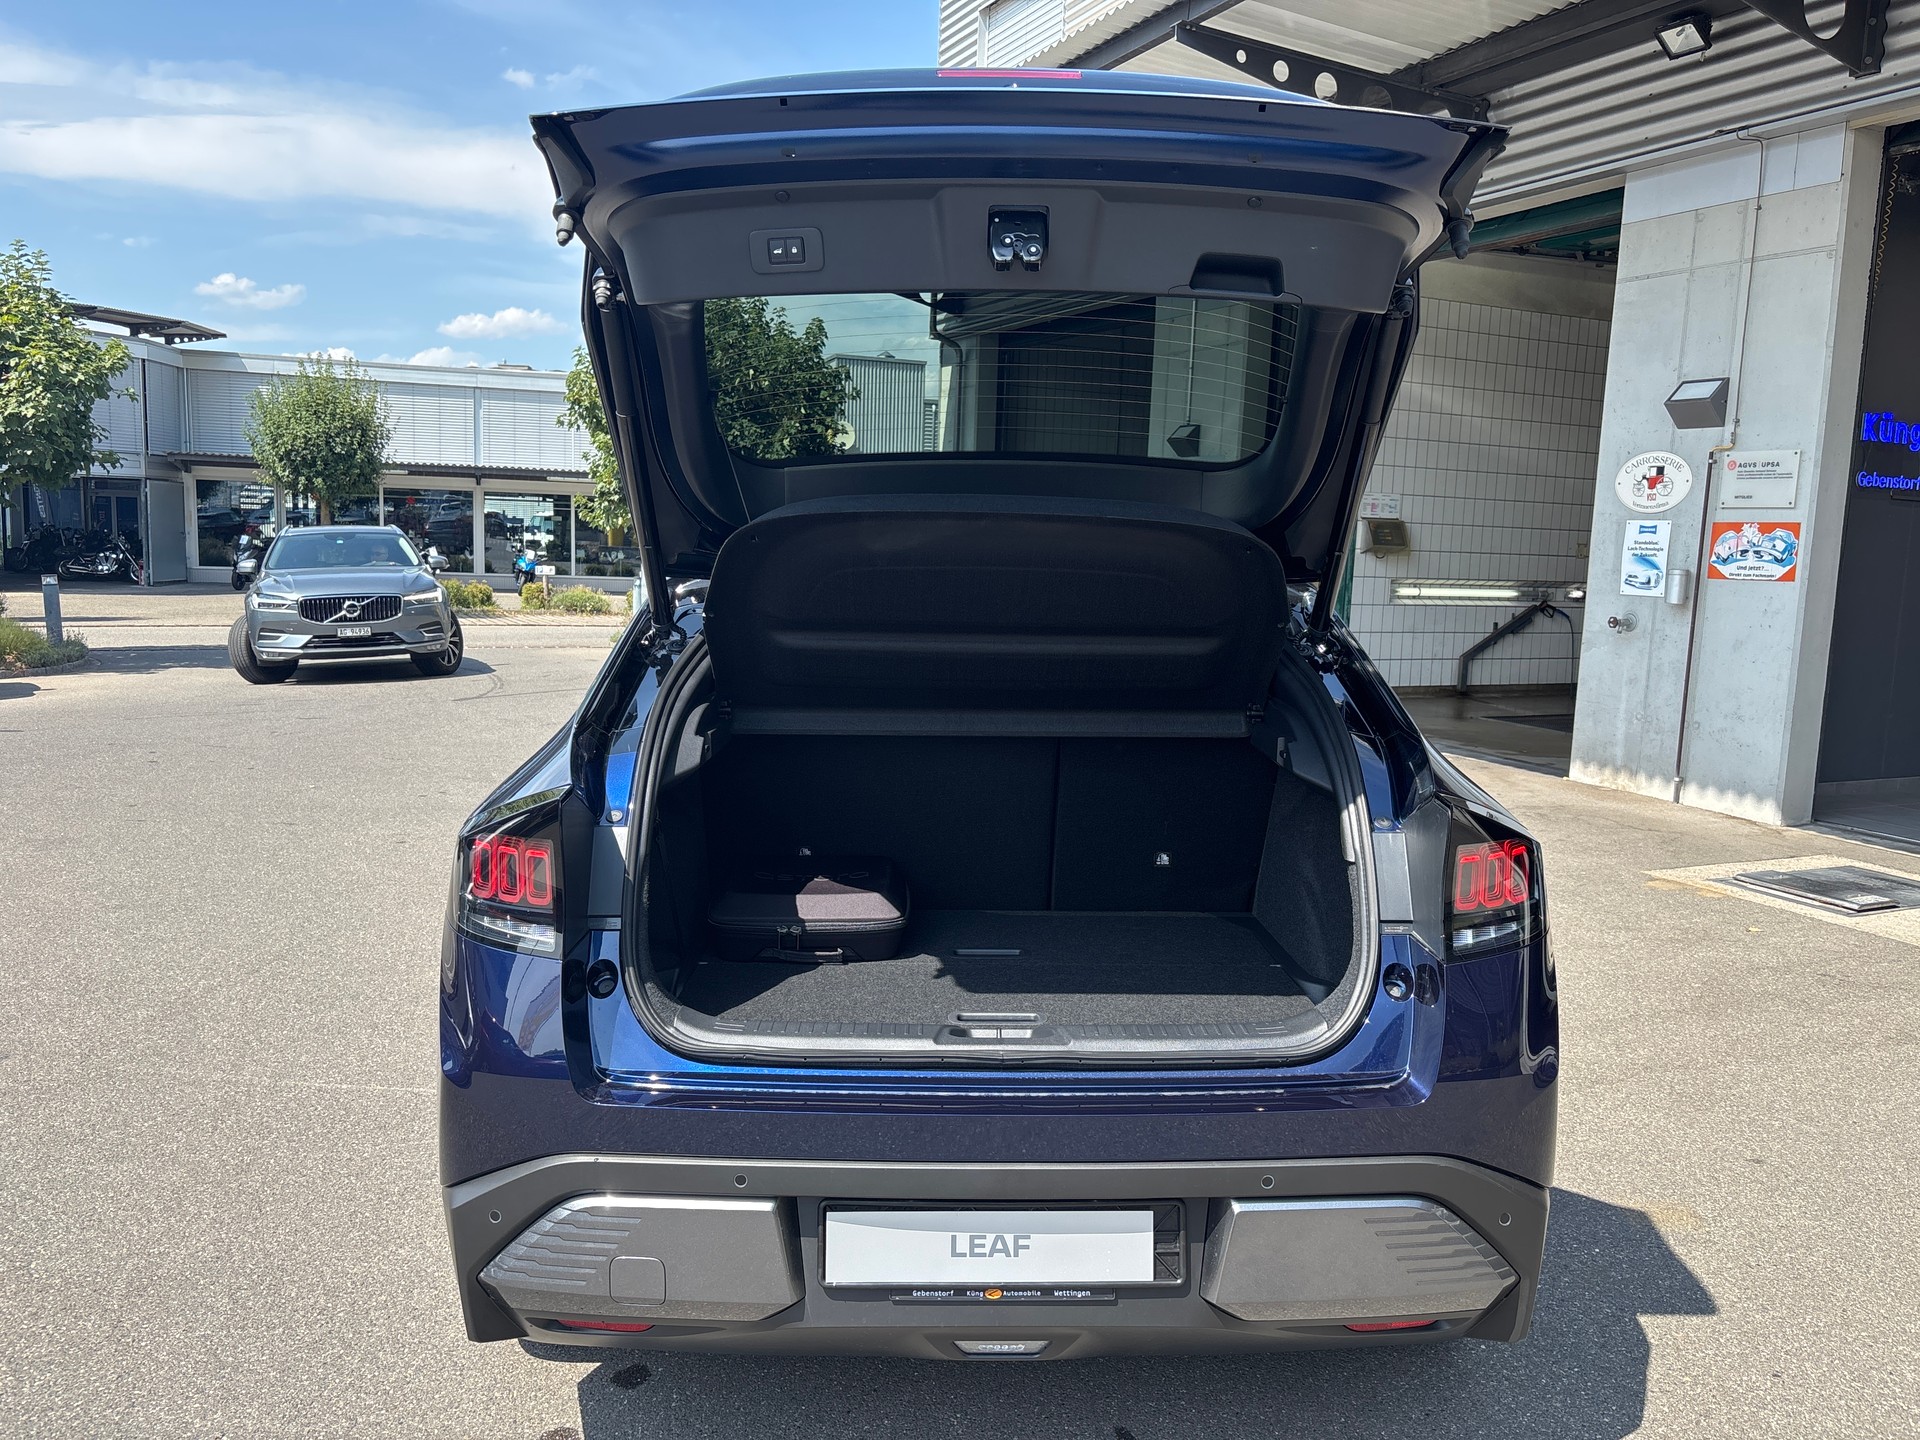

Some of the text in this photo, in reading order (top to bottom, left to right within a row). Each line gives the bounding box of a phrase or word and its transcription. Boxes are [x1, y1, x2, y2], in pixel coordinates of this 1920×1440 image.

[1862, 411, 1920, 452] Küng
[1624, 455, 1685, 475] CARROSSERIE
[340, 628, 348, 636] AG
[950, 1234, 1031, 1258] LEAF
[912, 1289, 954, 1297] Gebenstorf
[966, 1290, 984, 1298] Küng
[1054, 1289, 1091, 1297] Wettingen
